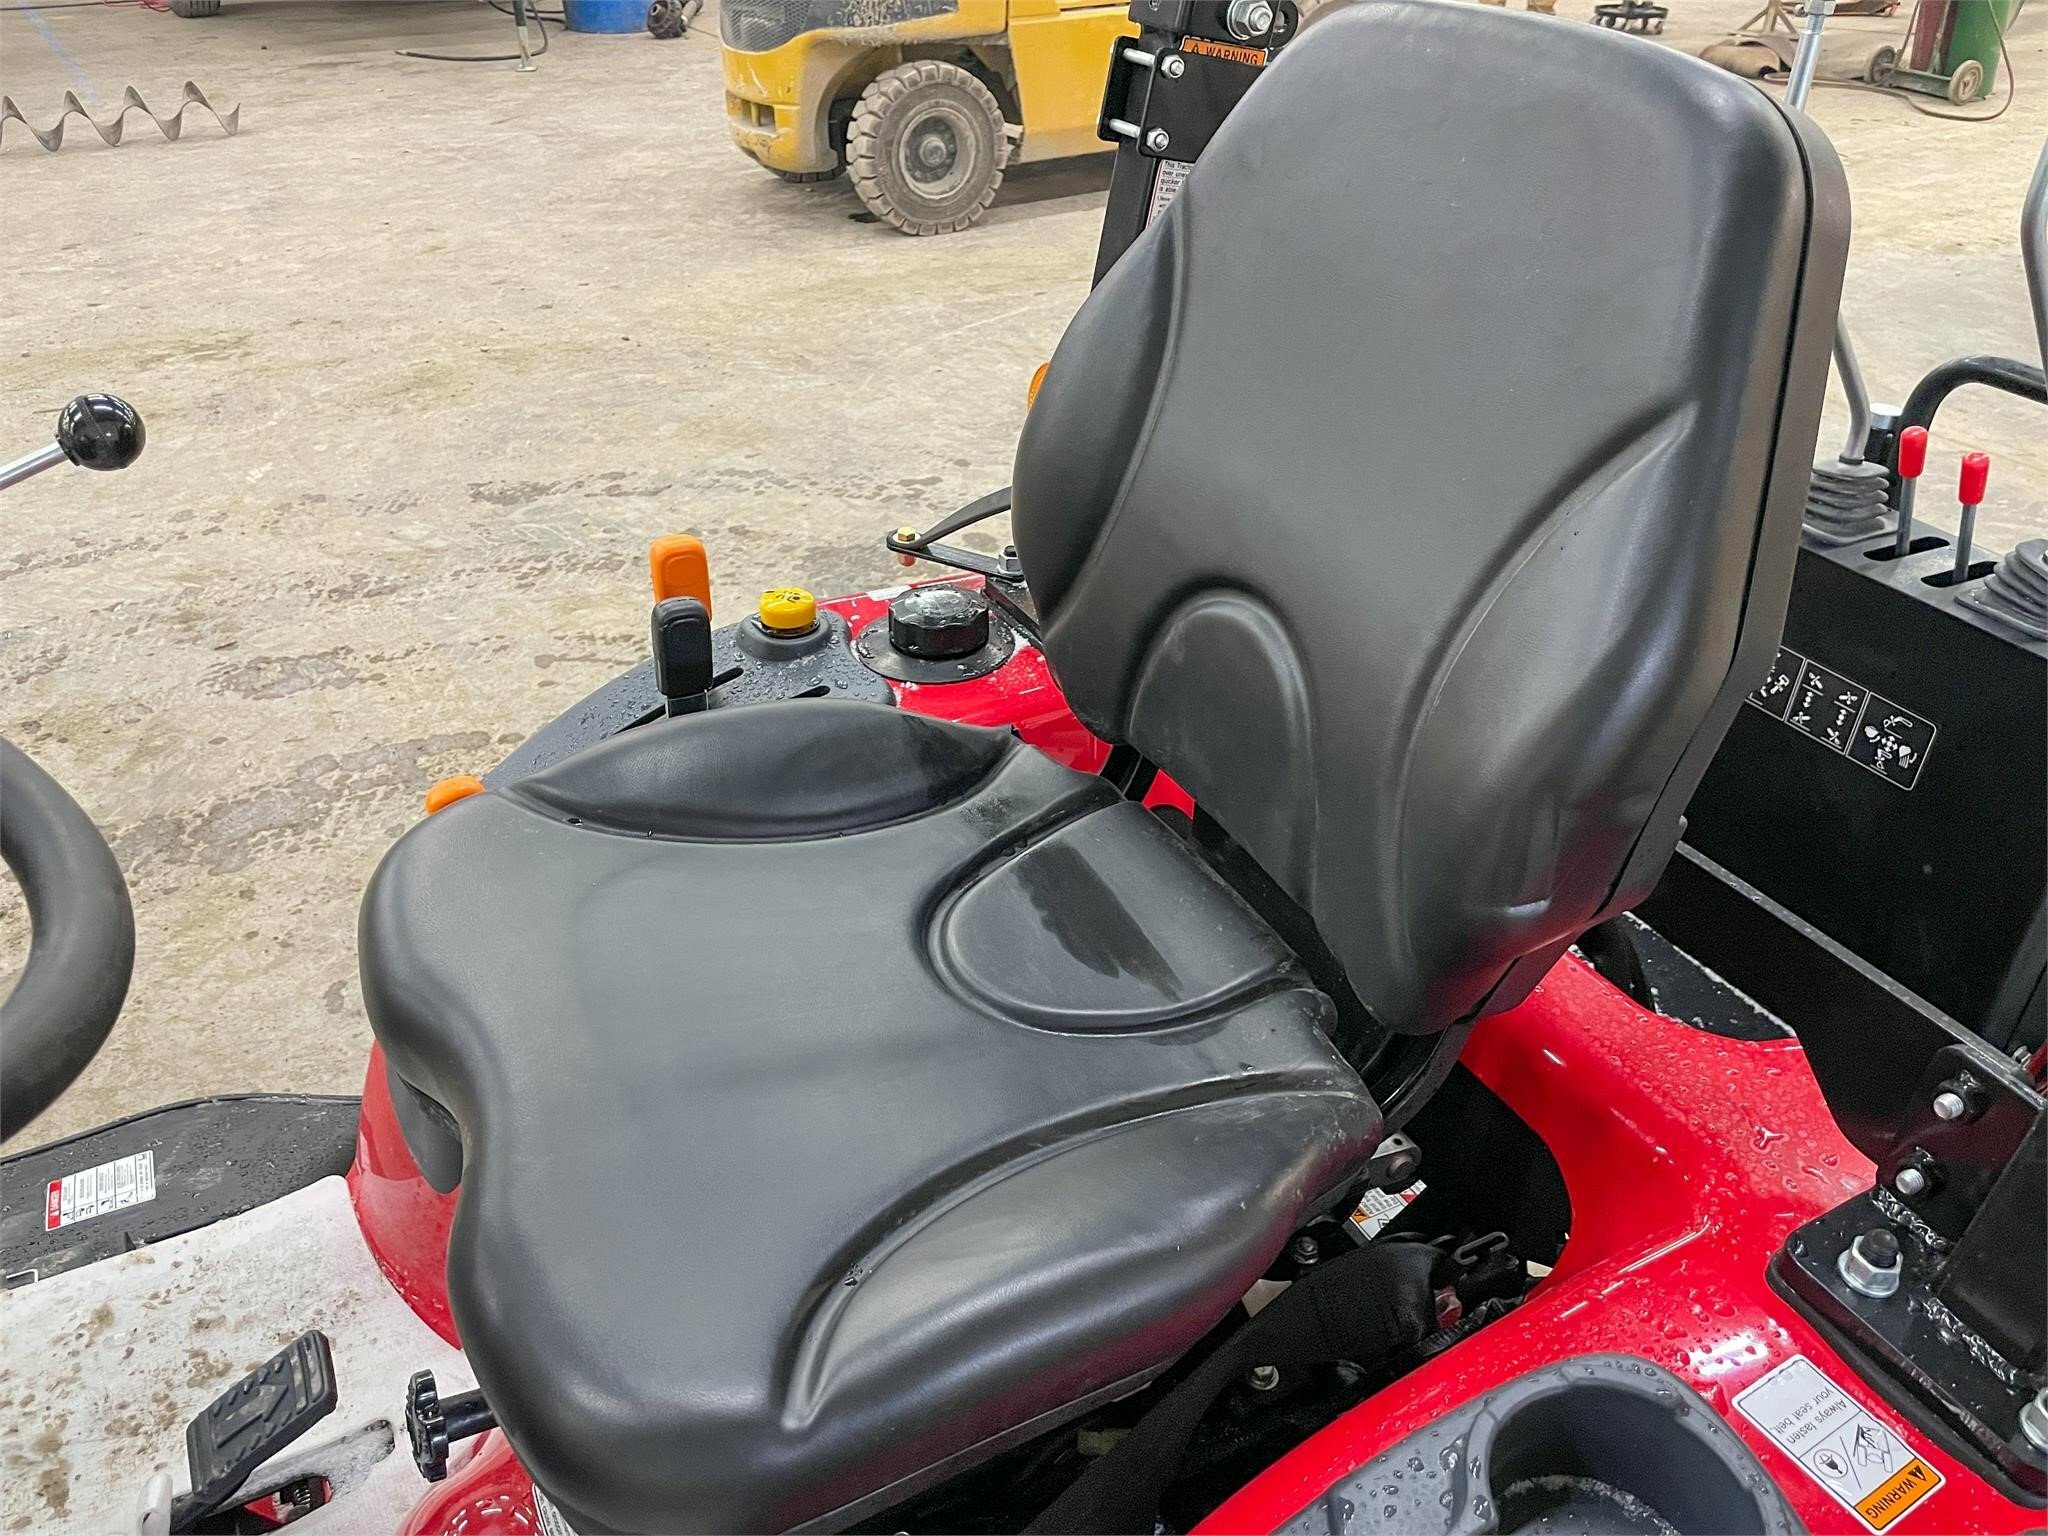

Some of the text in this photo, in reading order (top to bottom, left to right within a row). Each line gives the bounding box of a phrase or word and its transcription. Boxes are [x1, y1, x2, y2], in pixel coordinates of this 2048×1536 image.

[1206, 46, 1258, 65] WARNING
[1810, 1386, 1835, 1409] your
[1786, 1399, 1848, 1445] Always fasten
[1792, 1401, 1814, 1421] seat
[1866, 1480, 1917, 1519] WARNING
